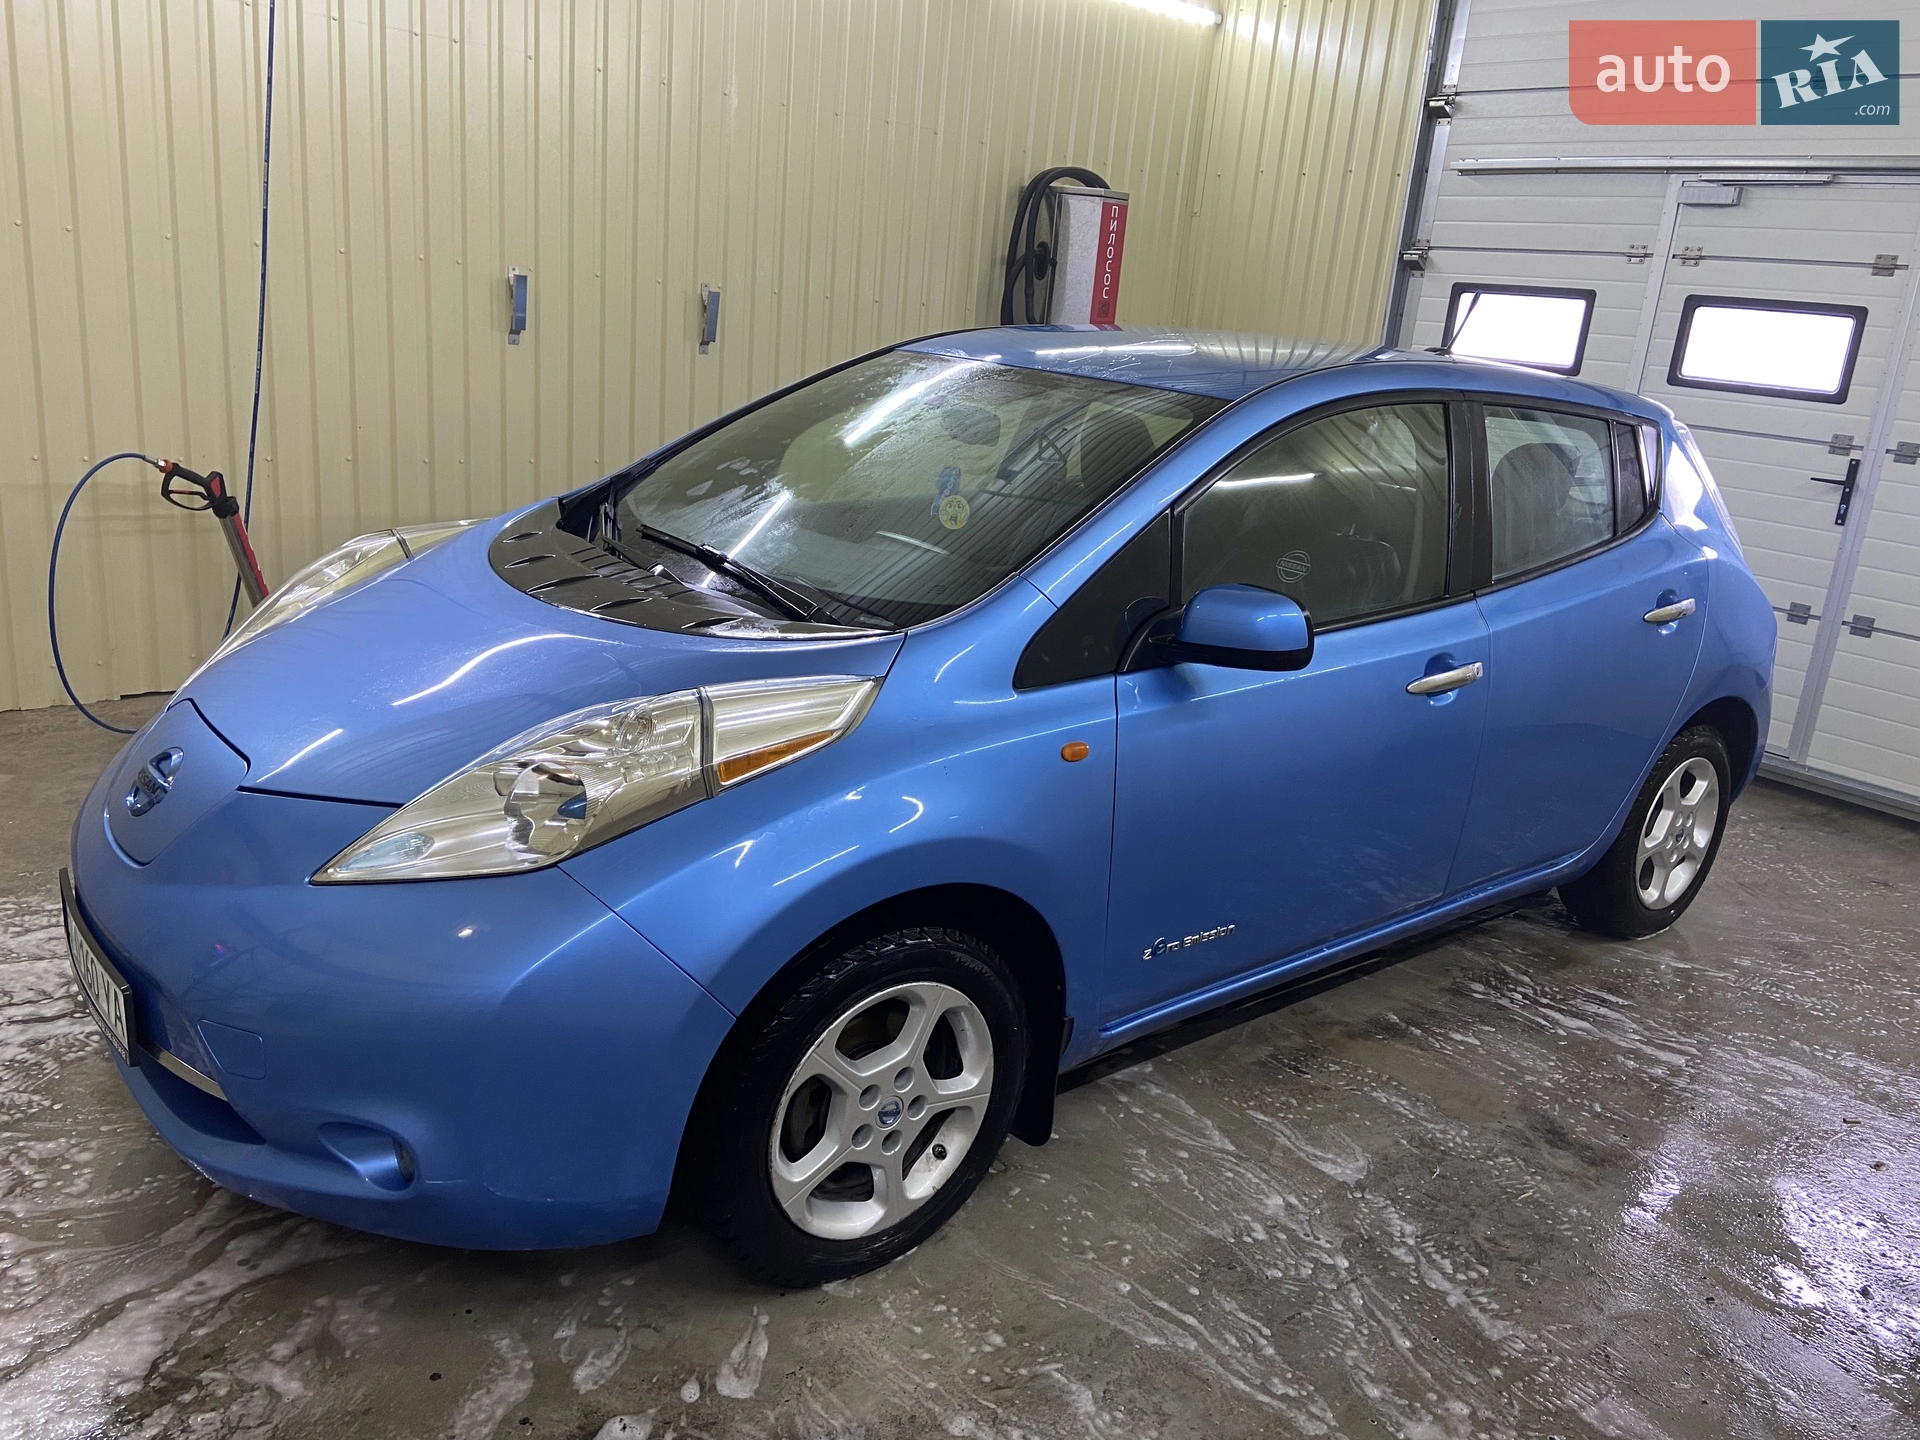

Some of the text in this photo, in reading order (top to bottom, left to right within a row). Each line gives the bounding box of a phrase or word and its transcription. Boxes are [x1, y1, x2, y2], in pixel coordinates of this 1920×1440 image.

[1102, 205, 1119, 299] ПИЛОСОС
[1279, 560, 1308, 573] NISSAN
[1183, 924, 1236, 947] Emission
